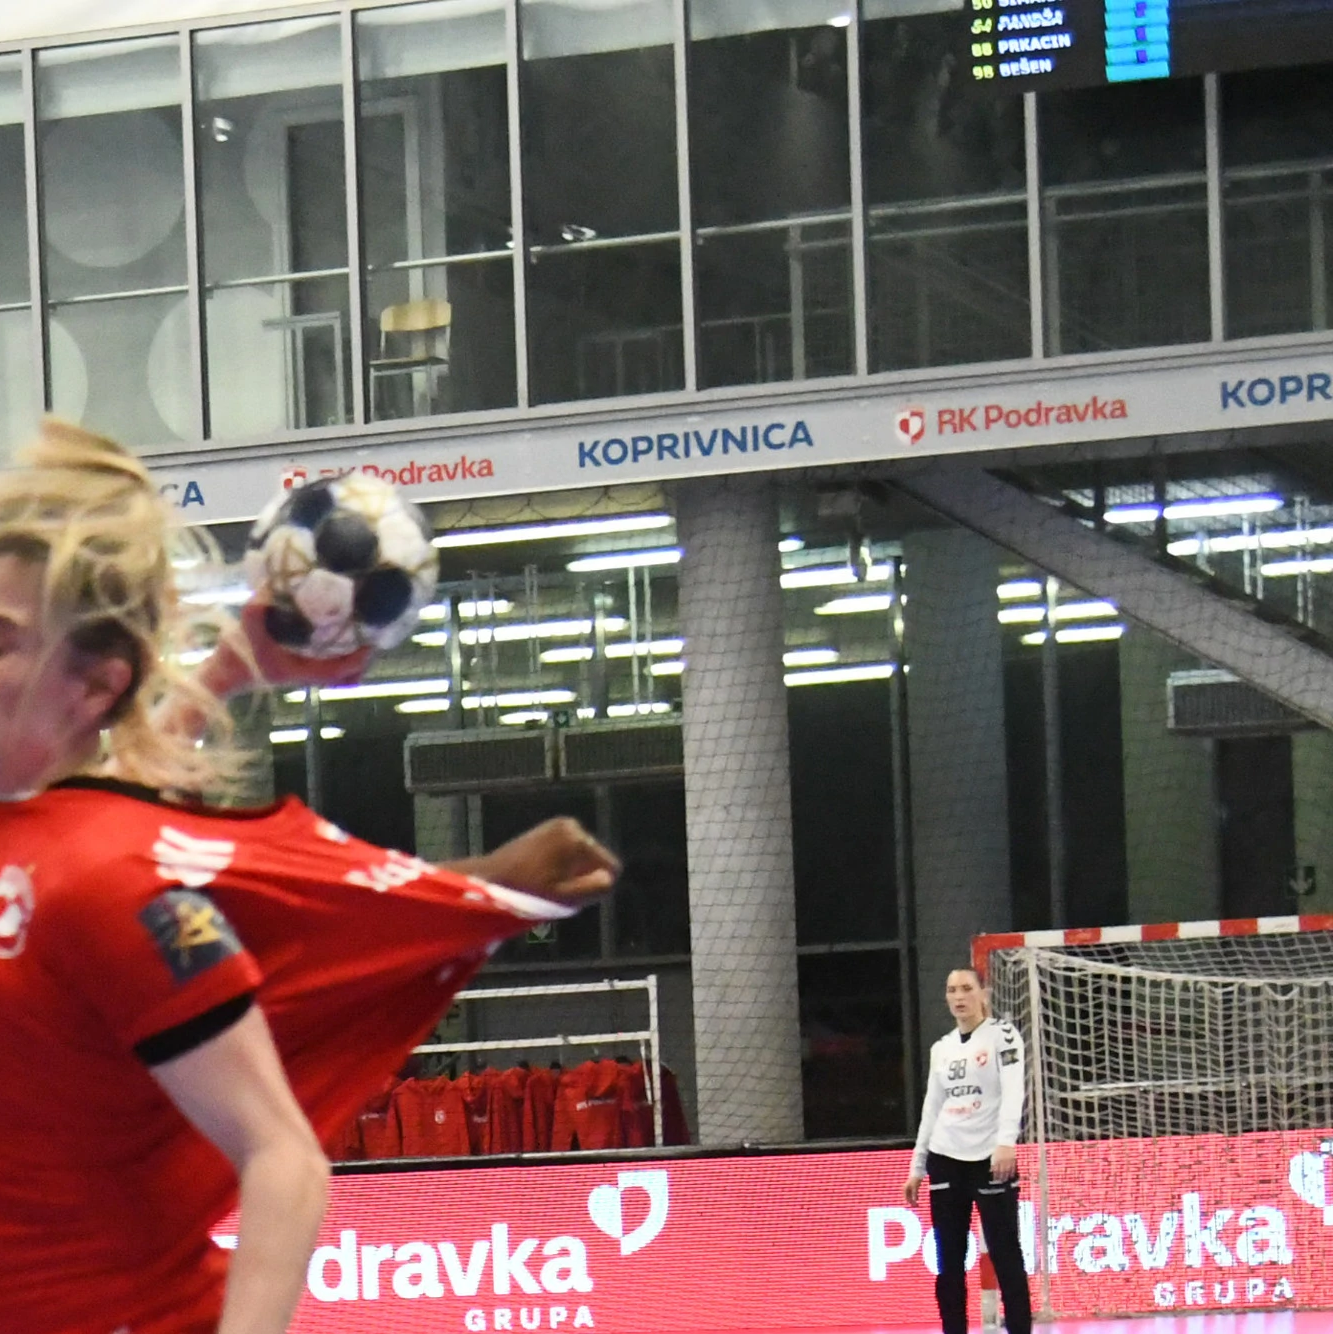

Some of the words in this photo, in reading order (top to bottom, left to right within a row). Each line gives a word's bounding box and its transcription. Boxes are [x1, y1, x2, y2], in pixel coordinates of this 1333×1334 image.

[937, 406, 979, 433] RK
[983, 396, 1127, 431] Podravka
[576, 421, 814, 468] KOPRIVNICA
[307, 1223, 594, 1302] dravka
[1153, 1279, 1294, 1307] GRUPA
[464, 1305, 594, 1332] GRUPA
